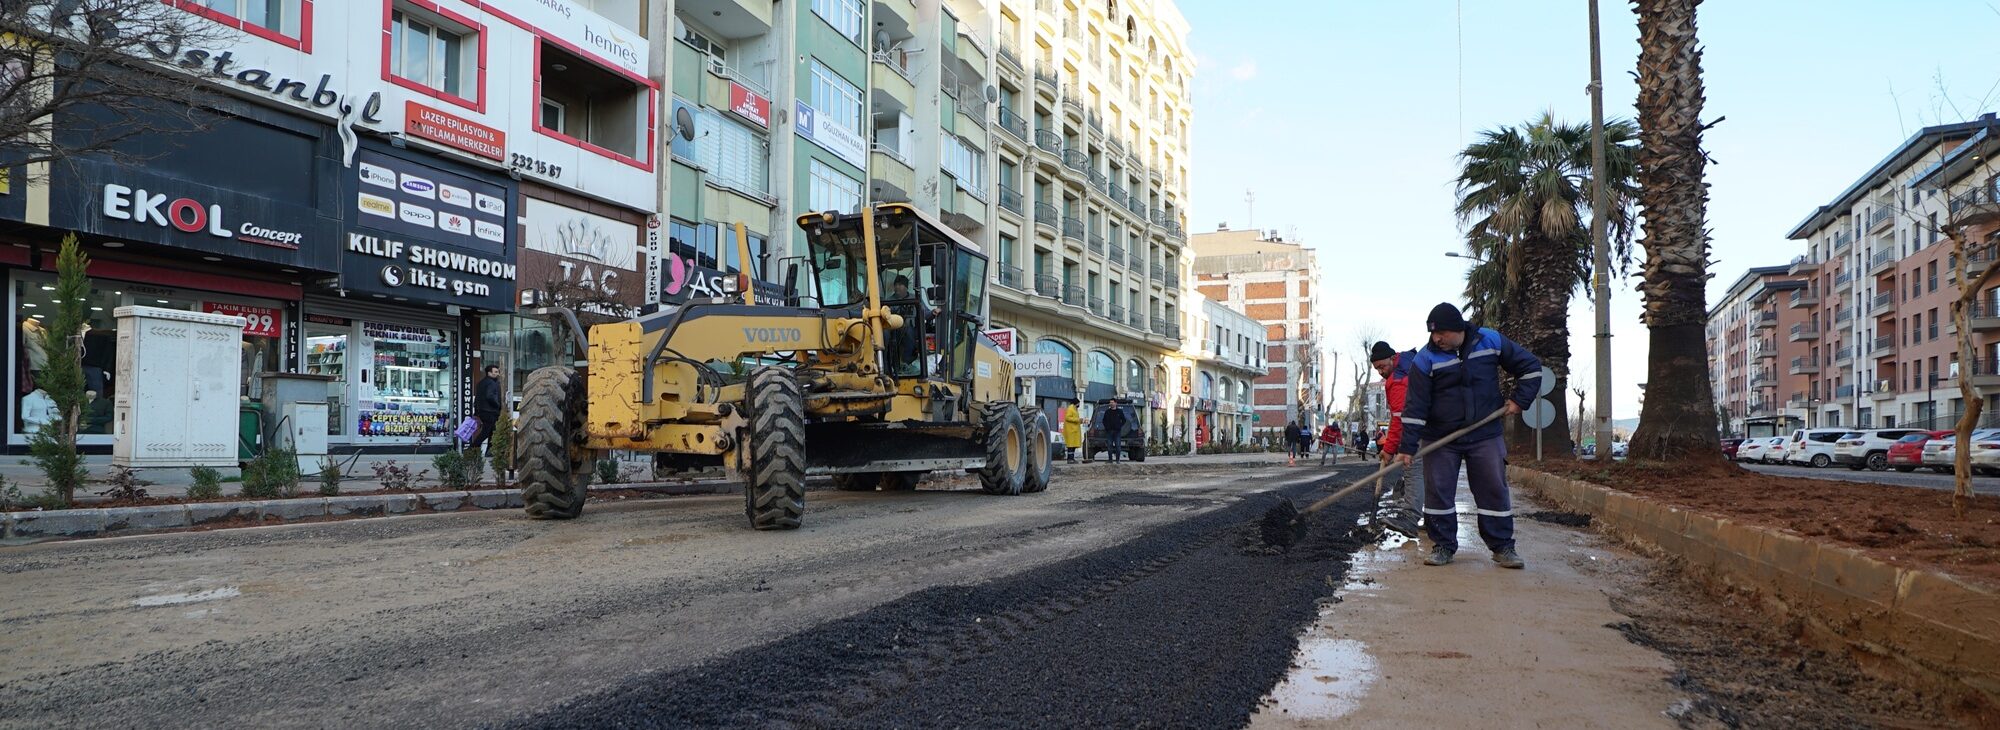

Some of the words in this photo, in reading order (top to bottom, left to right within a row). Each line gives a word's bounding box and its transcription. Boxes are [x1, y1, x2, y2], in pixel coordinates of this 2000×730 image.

[584, 24, 638, 65] hennes
[420, 109, 446, 126] LAZER
[447, 117, 488, 139] EPİLASYON
[488, 132, 495, 142] &
[457, 134, 503, 158] MERKEZLERİ
[511, 152, 533, 170] 232
[534, 160, 546, 174] 15
[549, 164, 562, 179] 87
[370, 172, 395, 185] iPhone
[406, 181, 430, 191] SAMSUNG
[363, 198, 390, 211] realme
[486, 201, 502, 212] iPad
[103, 183, 233, 238] EKOL
[239, 222, 302, 245] Concept
[348, 232, 403, 259] KILIF
[408, 245, 516, 280] SHOWROOM
[409, 268, 447, 290] ikiz
[452, 280, 490, 296] gsm
[212, 303, 239, 311] TAKIM
[363, 321, 430, 335] PROFESYONEL
[363, 329, 398, 340] TEKNİK
[401, 333, 433, 342] SERVİS
[743, 328, 801, 343] VOLVO
[1181, 367, 1191, 393] FLO
[372, 414, 398, 423] CEPTE
[412, 415, 438, 423] VARSA
